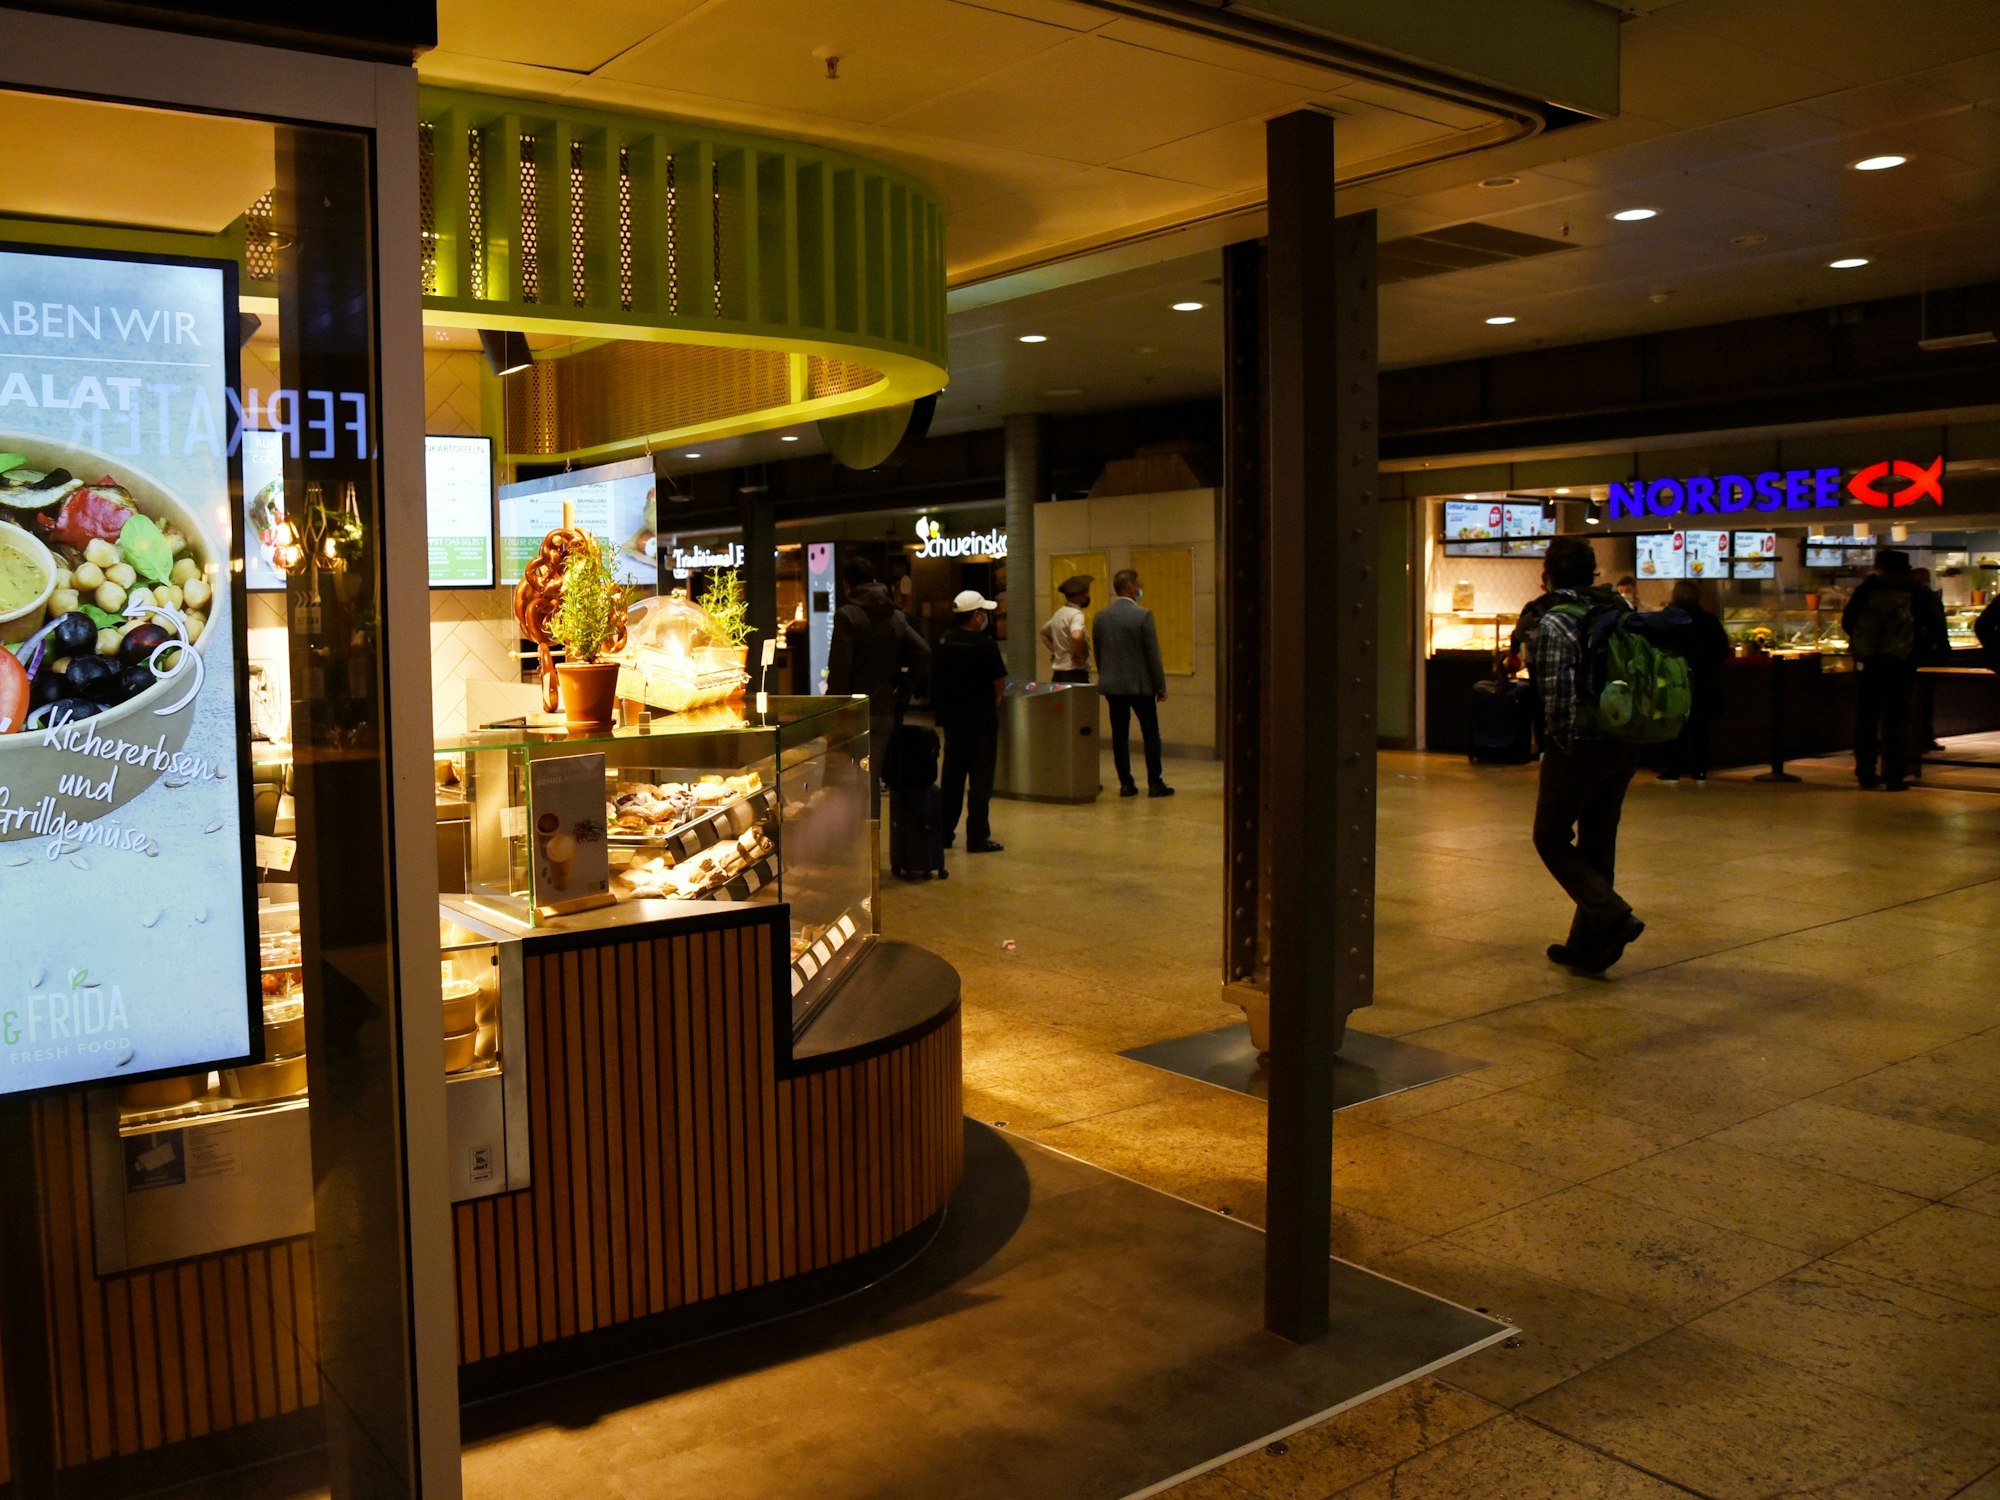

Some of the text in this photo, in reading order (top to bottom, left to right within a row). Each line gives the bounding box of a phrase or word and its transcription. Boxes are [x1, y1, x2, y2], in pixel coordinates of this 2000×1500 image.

[109, 306, 201, 346] WIR
[1608, 467, 1841, 520] NORDSEE
[672, 542, 734, 568] Traditional
[43, 705, 215, 780] Kichererbsen
[58, 764, 119, 803] und
[3, 984, 130, 1046] & FRIDA
[10, 1037, 131, 1065] FRESH FOOD
